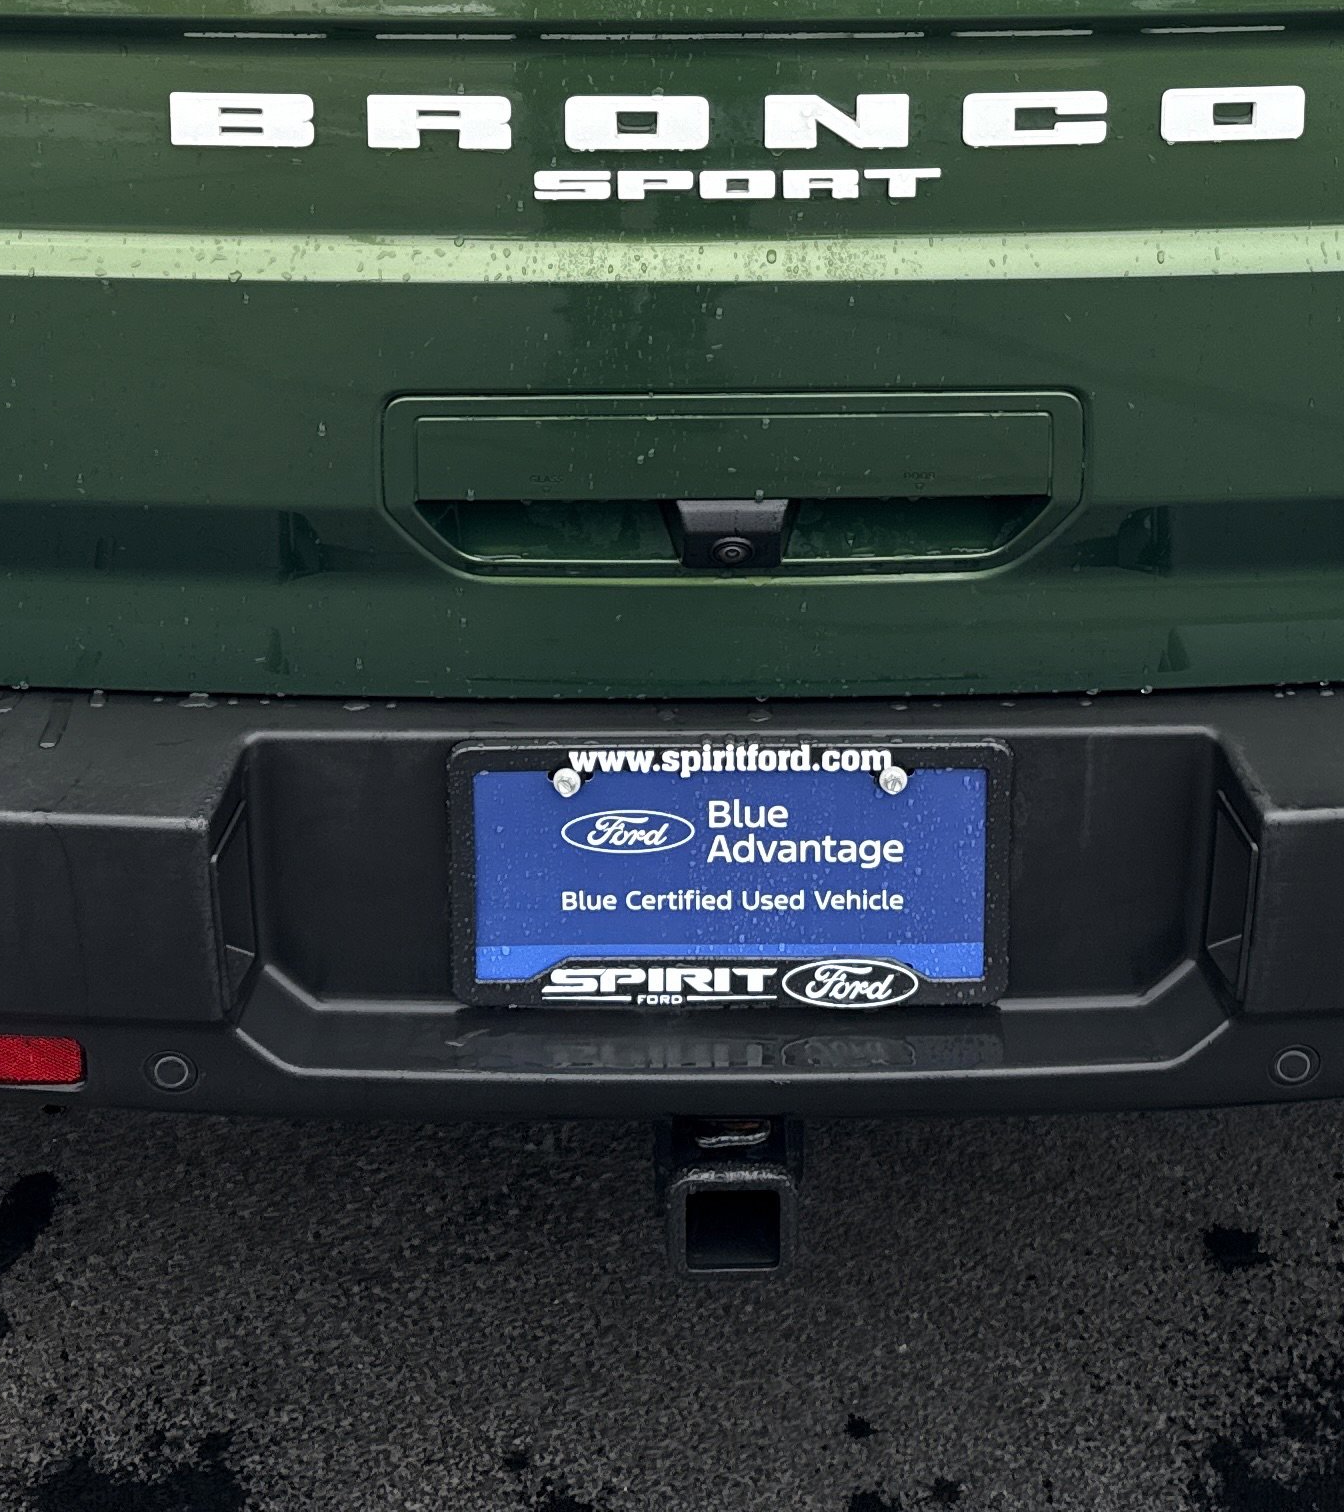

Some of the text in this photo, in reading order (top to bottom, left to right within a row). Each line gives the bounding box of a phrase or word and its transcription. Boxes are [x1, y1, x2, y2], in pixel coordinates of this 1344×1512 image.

[169, 85, 1306, 152] BRONCO
[533, 167, 943, 202] SPORT
[568, 743, 892, 778] www.spiritford.com
[586, 815, 669, 846] Ford
[708, 799, 789, 829] Blue
[706, 833, 905, 869] Advantage
[561, 889, 904, 911] Blue Certified Used Vehicle
[541, 967, 778, 993] SPIRIT
[805, 964, 895, 1000] Ford
[636, 994, 684, 1006] FORD
